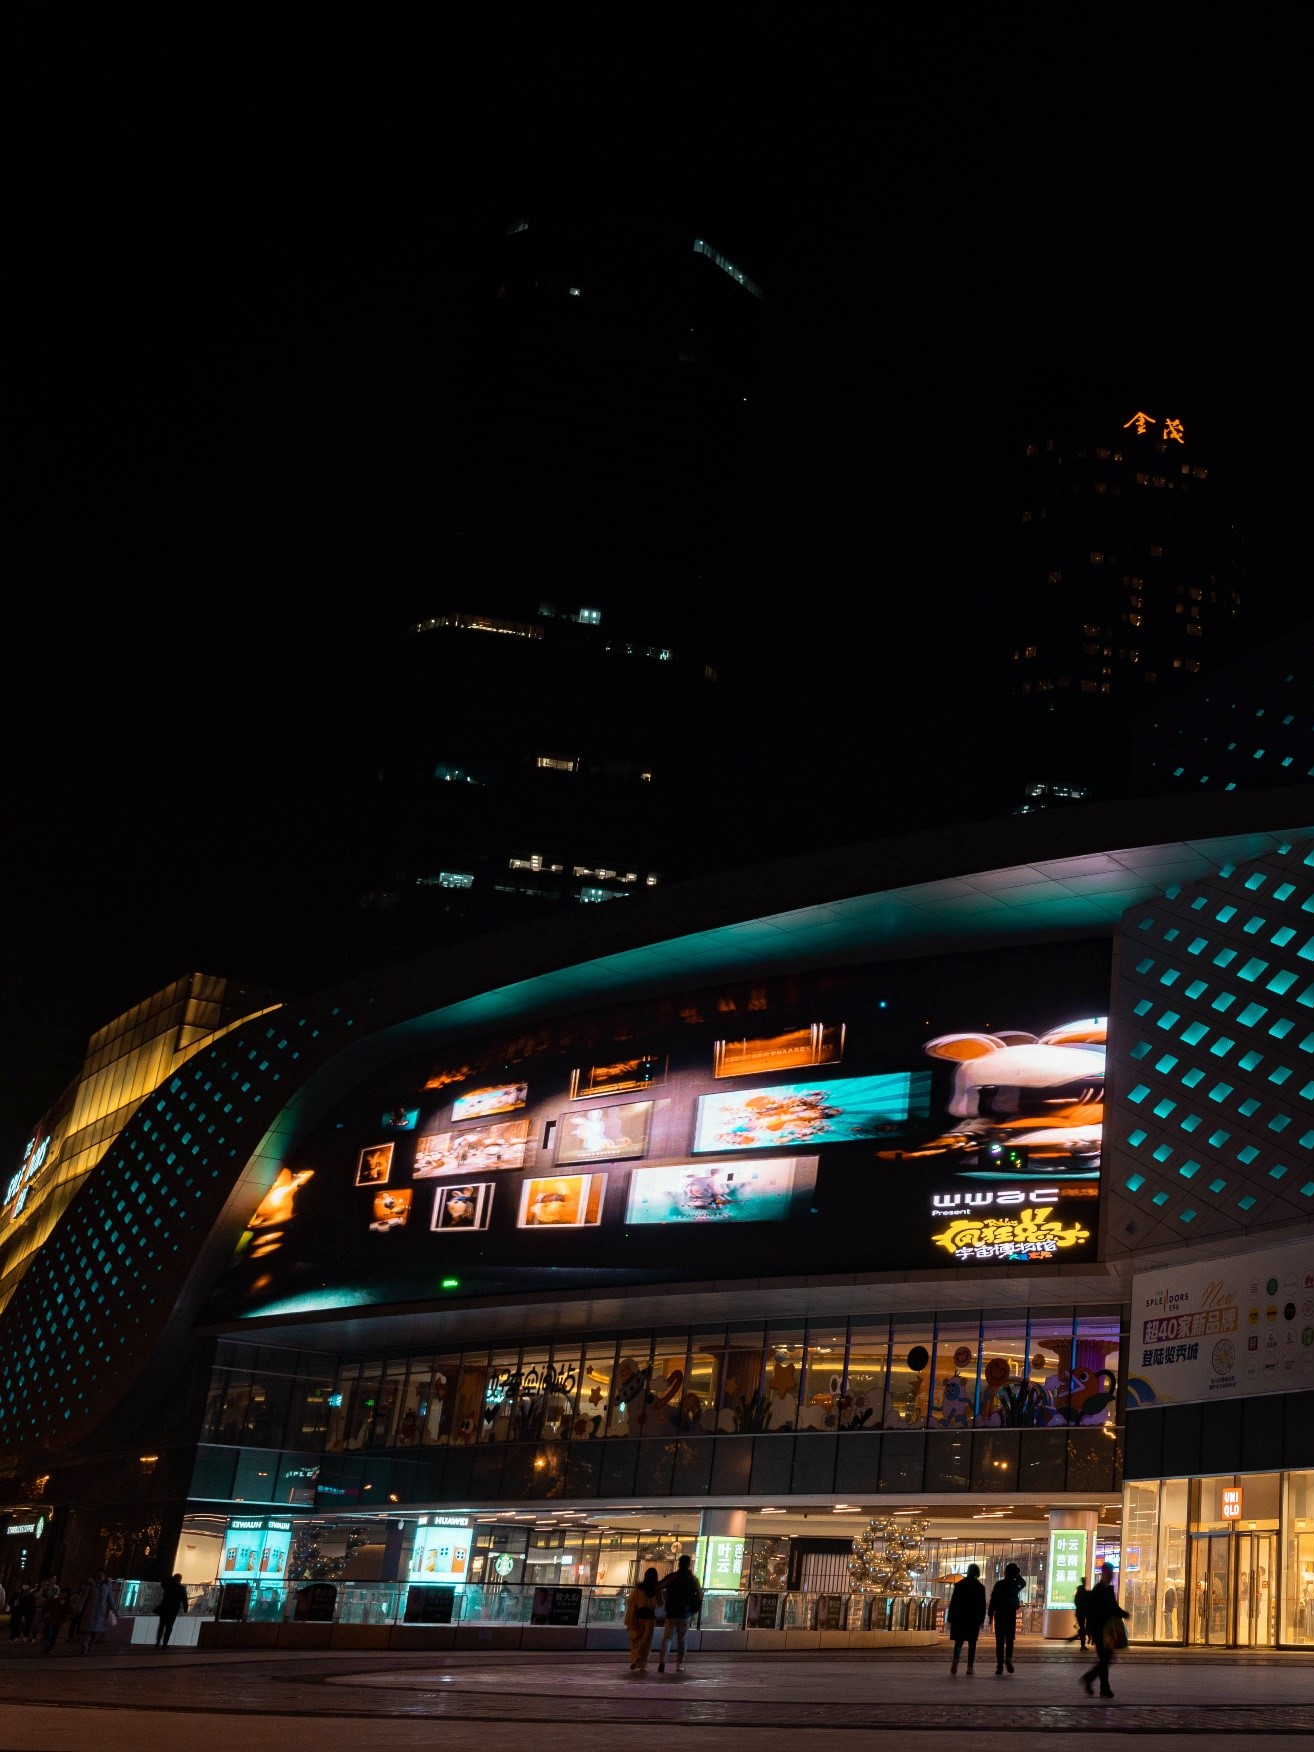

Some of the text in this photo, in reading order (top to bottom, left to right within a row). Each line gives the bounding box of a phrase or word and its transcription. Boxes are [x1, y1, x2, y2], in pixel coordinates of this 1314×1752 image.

[932, 1208, 971, 1216] Present
[932, 1207, 1090, 1253] 疯狂兔子
[955, 1240, 1057, 1260] 宇宙博物馆
[1146, 1288, 1189, 1311] SPLENDORS
[1144, 1309, 1237, 1342] 超40家新品牌
[1142, 1343, 1199, 1367] 登陆览秀城
[1224, 1491, 1239, 1503] UNI
[1224, 1504, 1240, 1517] QLO
[434, 1517, 469, 1526] HUAWEI
